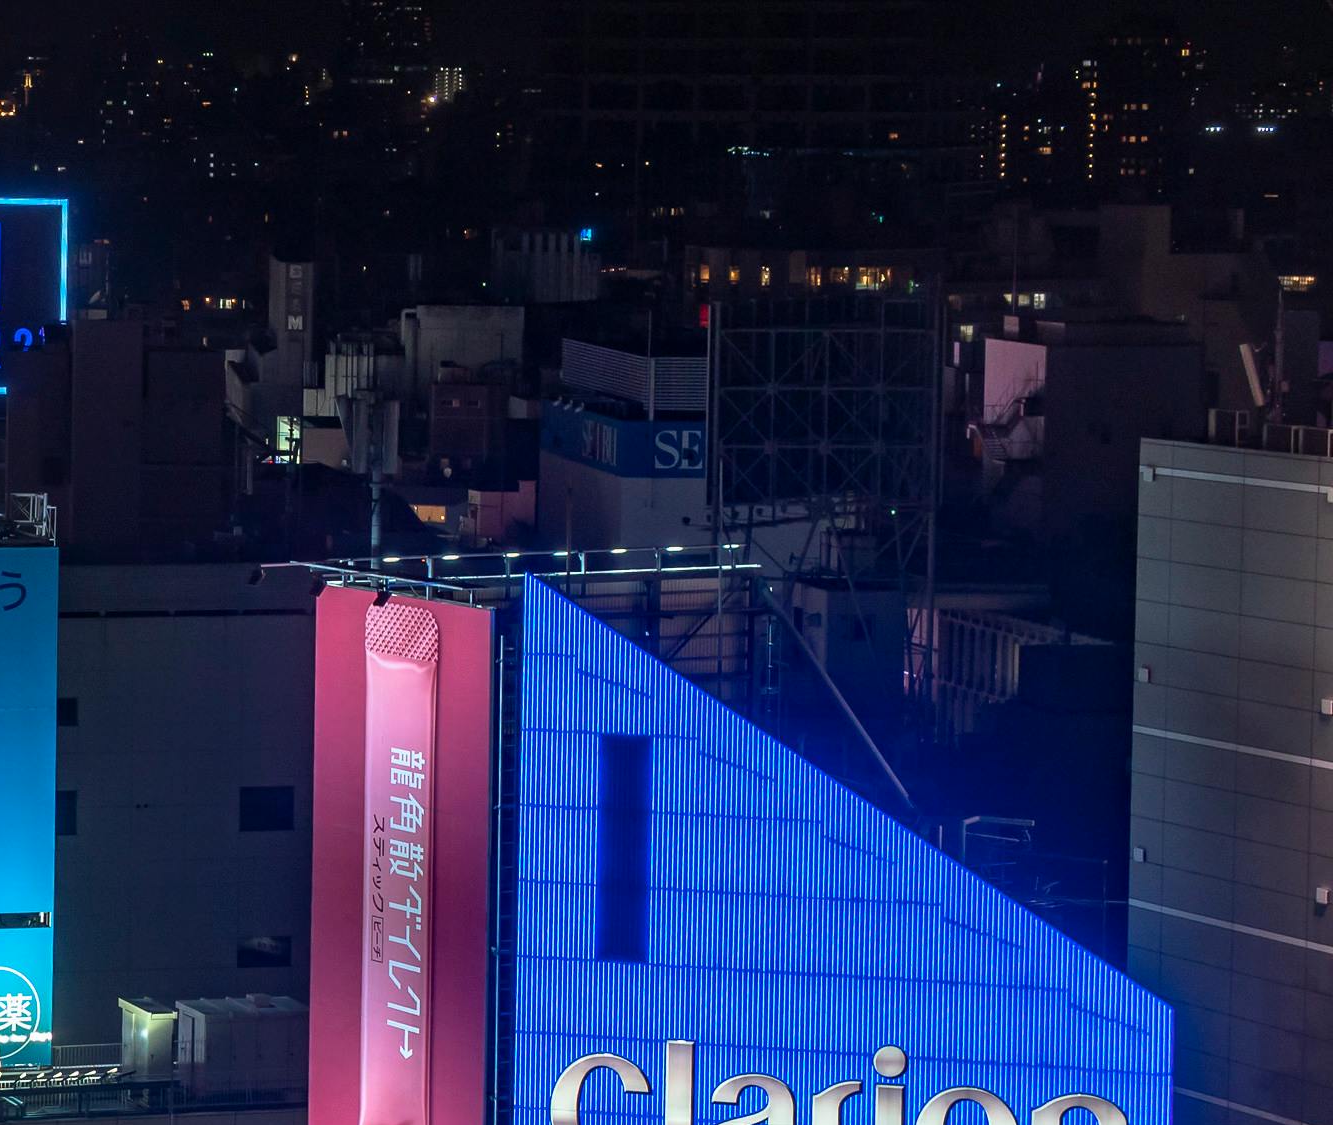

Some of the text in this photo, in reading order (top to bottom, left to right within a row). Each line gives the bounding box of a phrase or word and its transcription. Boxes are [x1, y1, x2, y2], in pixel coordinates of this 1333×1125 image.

[387, 745, 426, 1060] 龍角散ダイレクト
